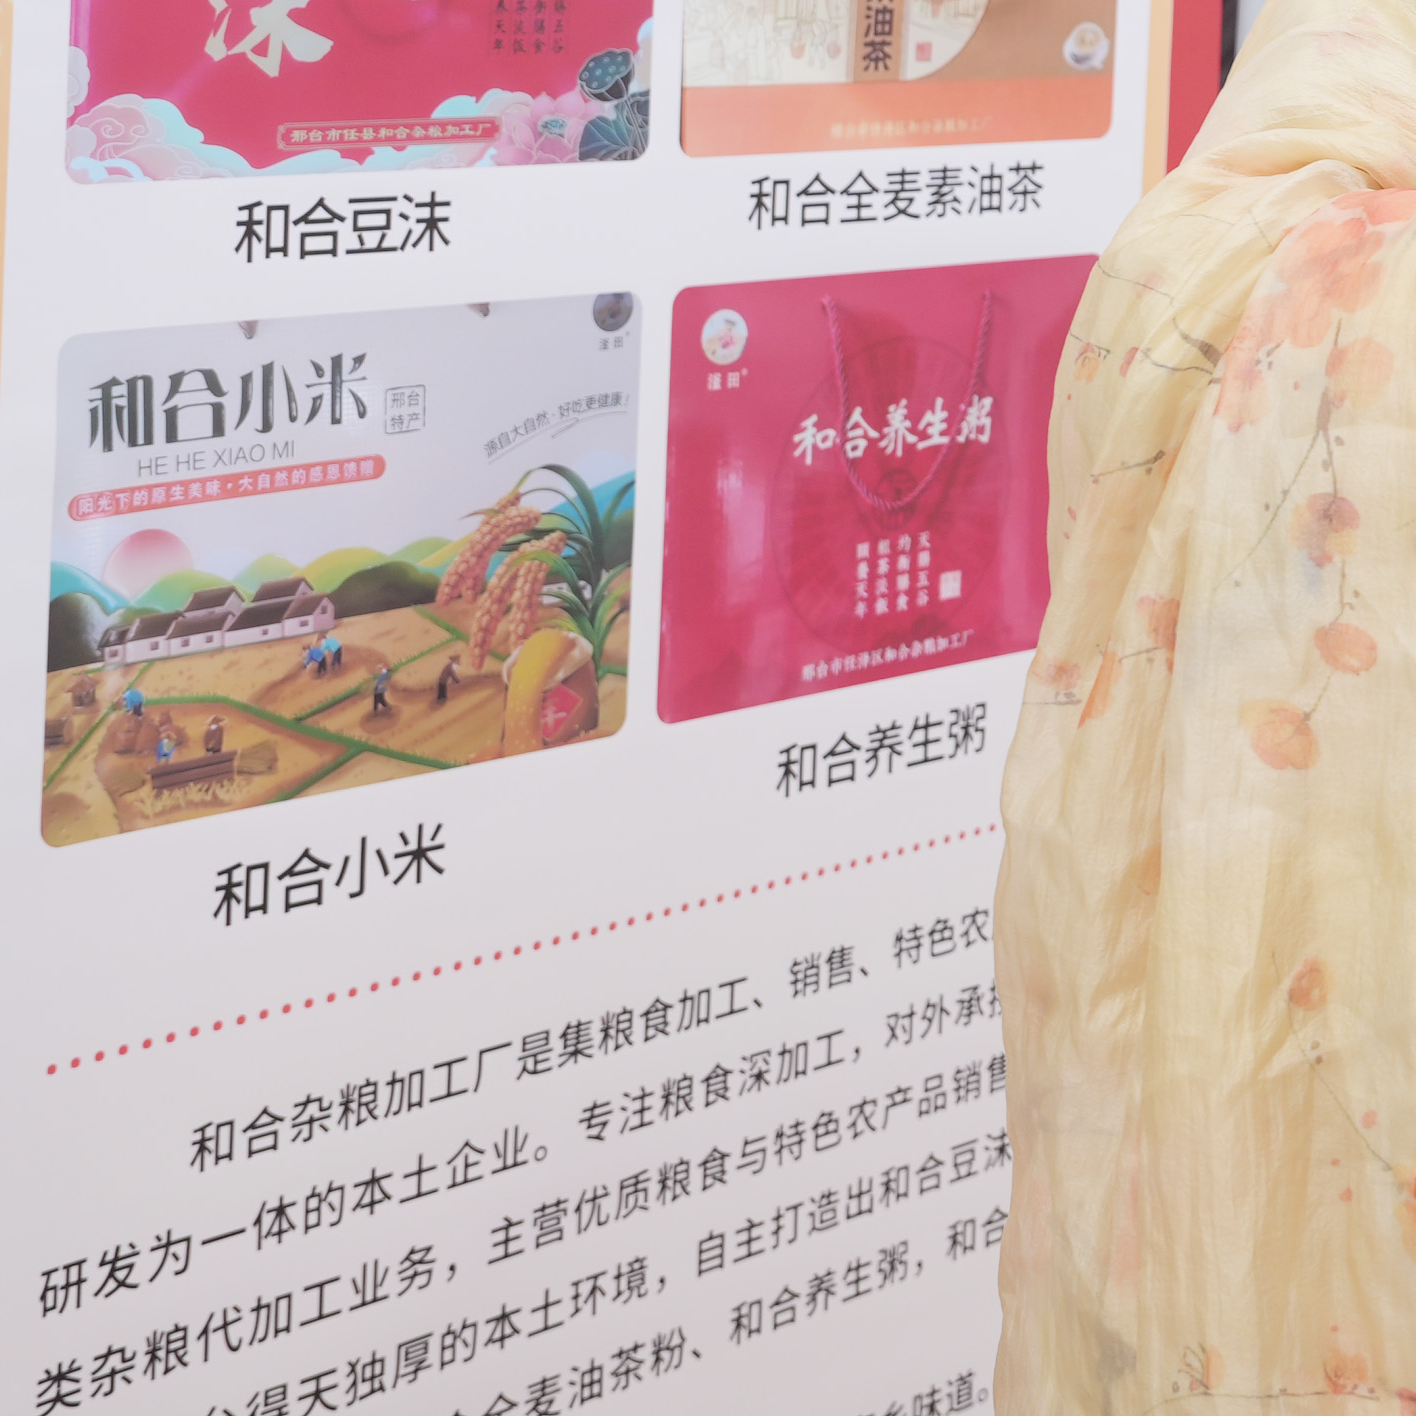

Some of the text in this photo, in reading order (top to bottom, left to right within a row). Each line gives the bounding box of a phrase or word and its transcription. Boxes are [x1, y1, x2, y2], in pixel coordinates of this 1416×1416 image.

[233, 190, 453, 264] 和合豆沫
[747, 160, 1045, 232] 和合全麦素油茶
[88, 351, 369, 455] 和合小米
[390, 389, 421, 409] 邢台
[390, 411, 422, 431] 特产
[793, 394, 994, 466] 和合养生粥
[138, 439, 296, 477] HE HE XIAO MI
[775, 701, 988, 799] 和合养生粥
[212, 822, 447, 928] 和合小米
